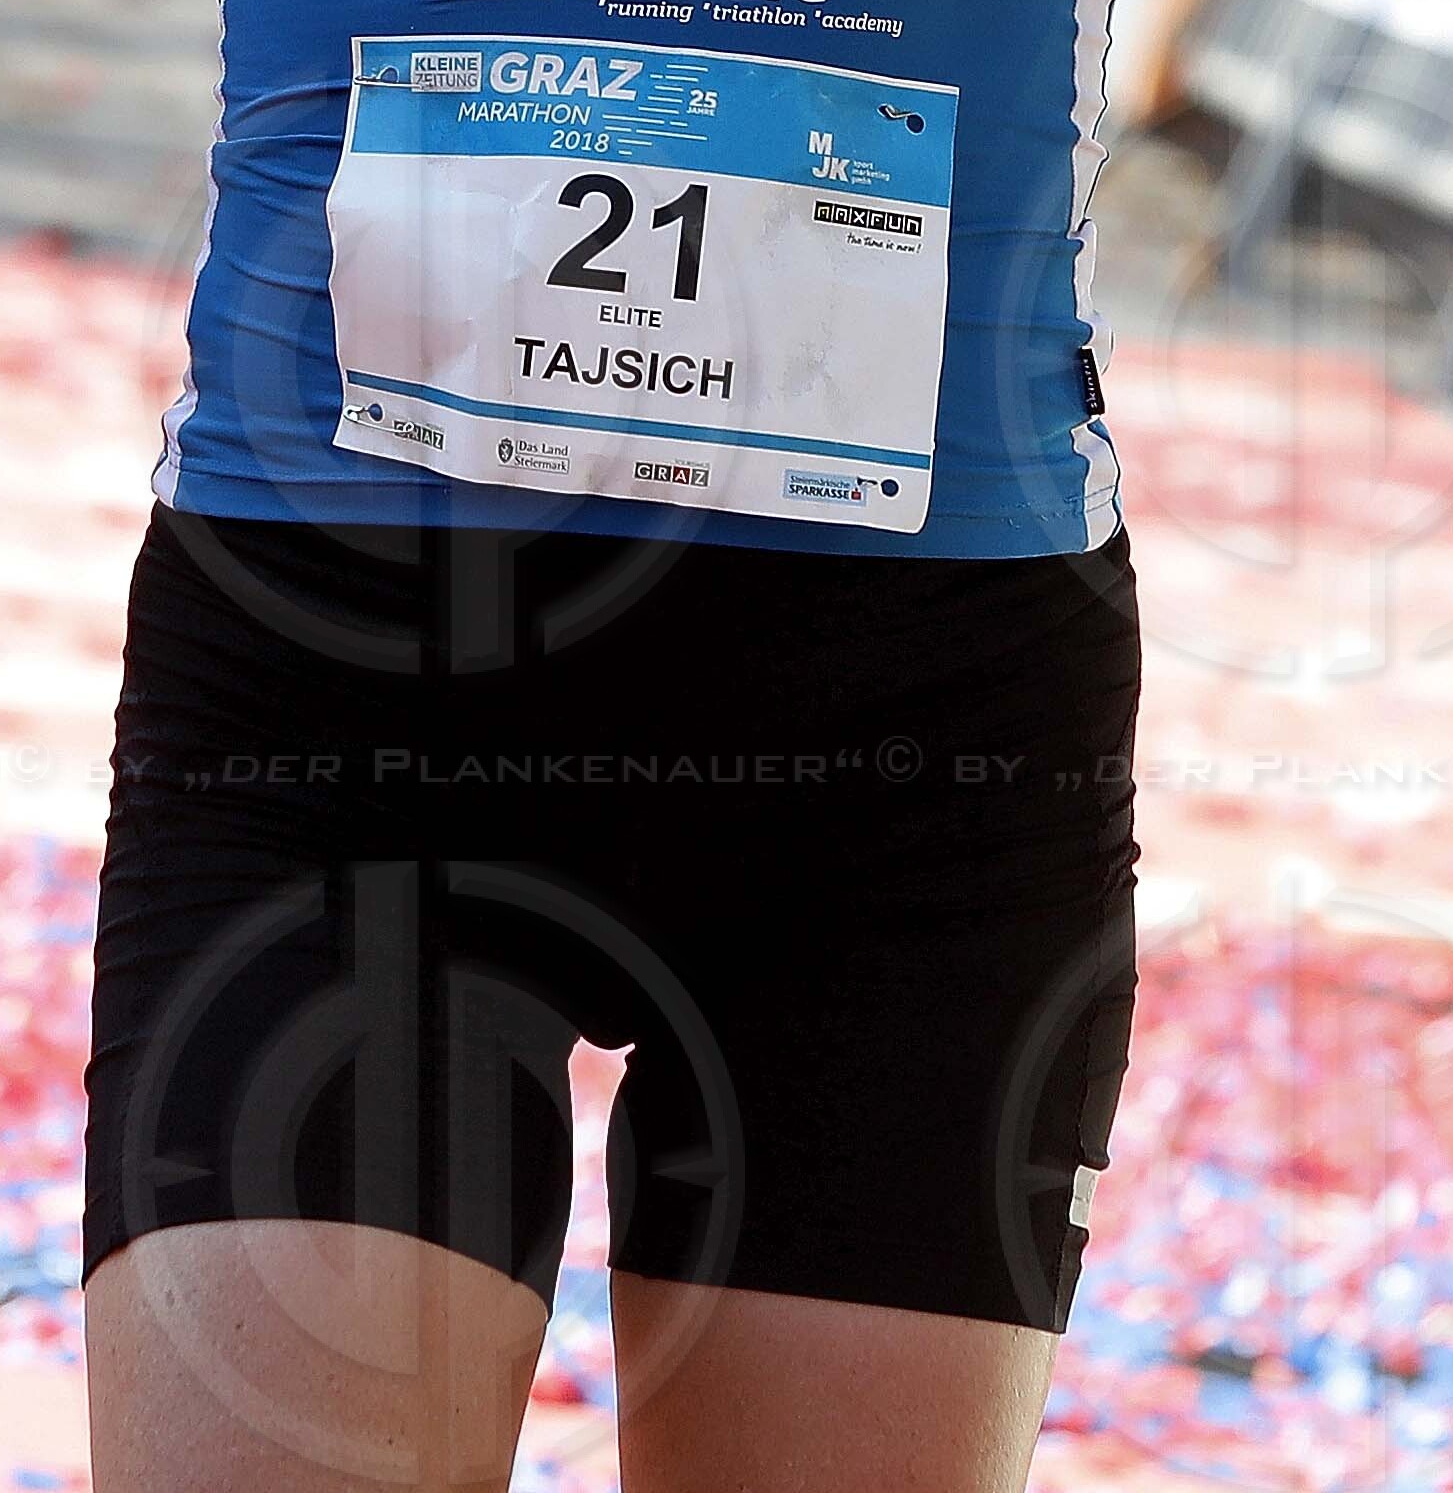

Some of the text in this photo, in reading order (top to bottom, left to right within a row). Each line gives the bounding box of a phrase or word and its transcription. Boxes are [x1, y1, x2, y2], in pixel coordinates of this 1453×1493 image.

[415, 51, 644, 102] KLEINE GRAZ
[415, 72, 478, 88] ZEITUNG
[686, 105, 716, 117] JAHRE
[689, 90, 718, 109] 25
[457, 101, 591, 126] MARATHON
[550, 130, 610, 153] 2018
[547, 173, 709, 302] 21
[599, 305, 663, 328] ELITE
[514, 337, 734, 400] TAJSICH
[518, 440, 539, 454] Das
[542, 443, 569, 457] Land
[514, 456, 567, 472] Steiermark
[636, 463, 706, 486] GRAZ
[788, 484, 850, 500] SPARKASSE
